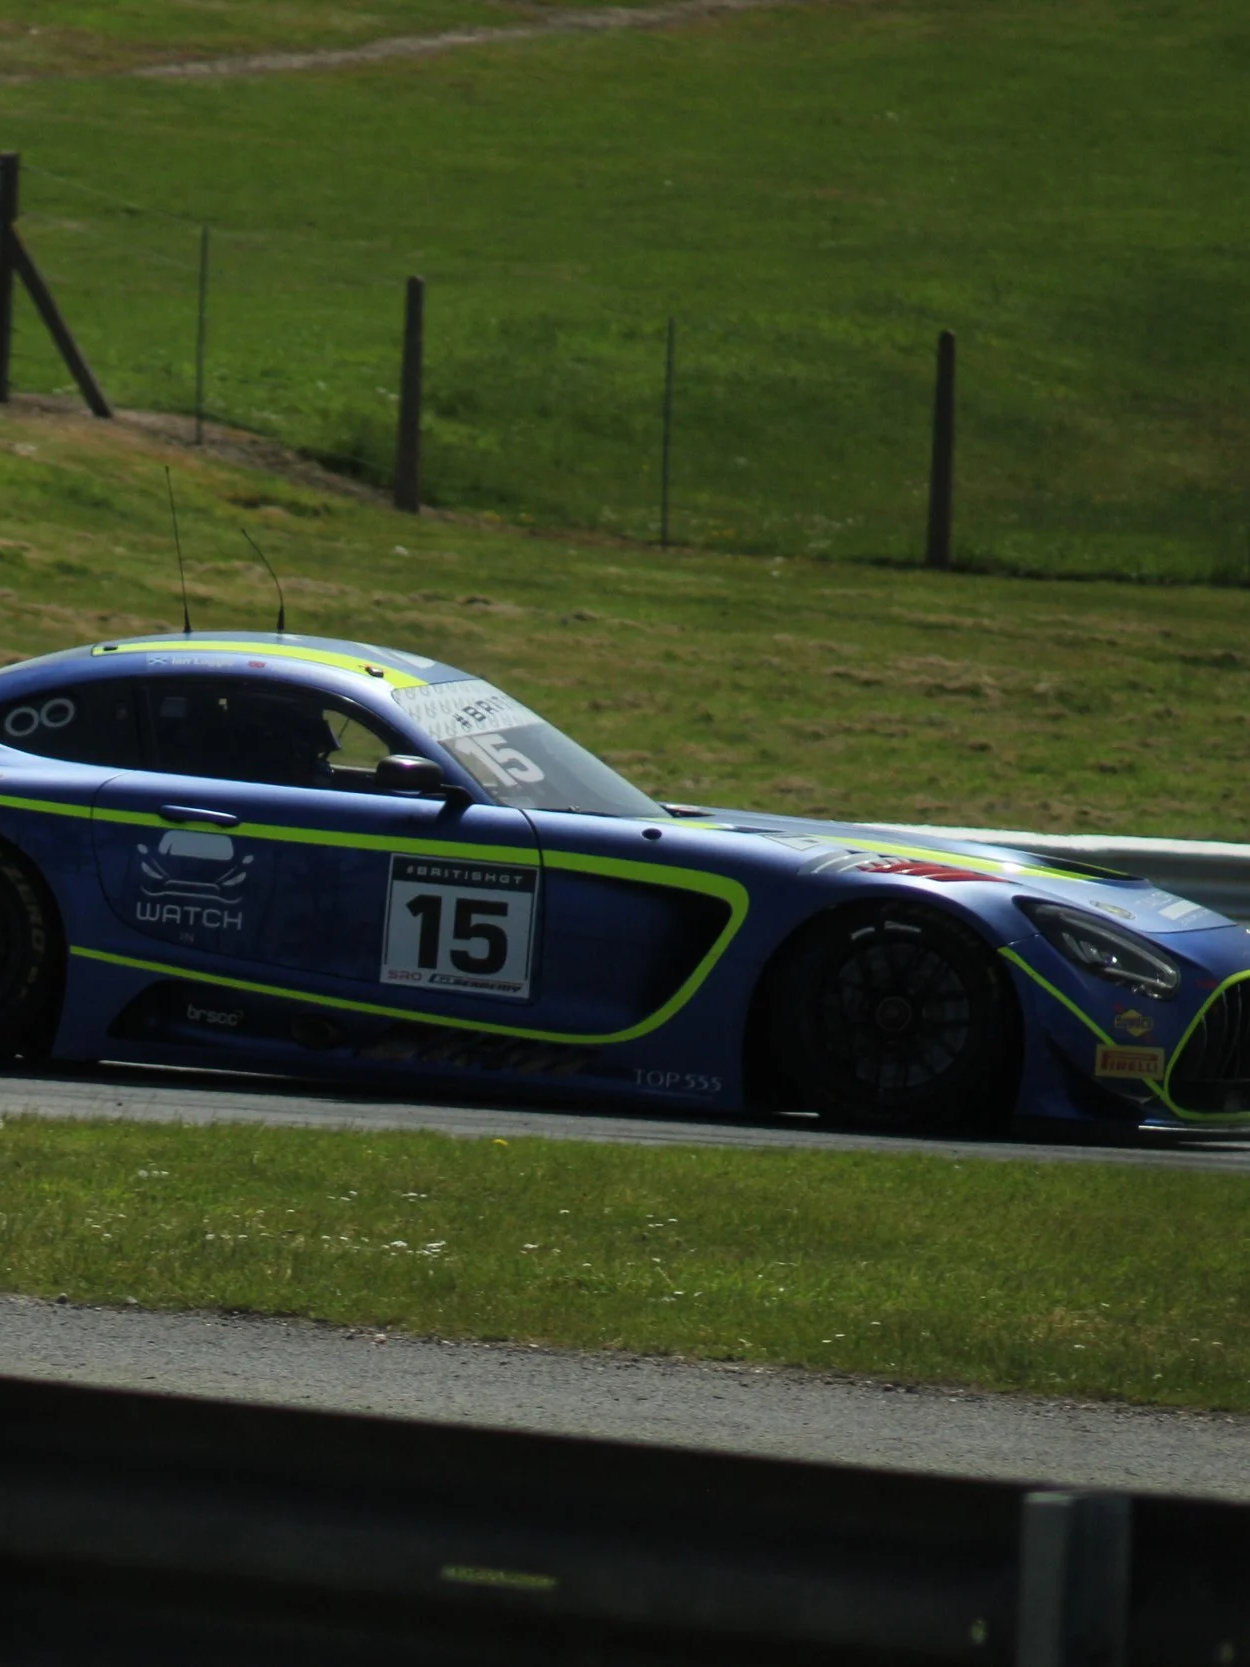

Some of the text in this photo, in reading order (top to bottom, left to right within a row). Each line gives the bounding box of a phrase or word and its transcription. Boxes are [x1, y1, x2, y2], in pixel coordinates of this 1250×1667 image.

[455, 733, 545, 787] 15
[406, 865, 522, 884] #BRITISHGT
[136, 901, 243, 930] WATCH
[406, 894, 508, 974] 15
[388, 970, 422, 982] SRO
[633, 1068, 724, 1093] TOP 555
